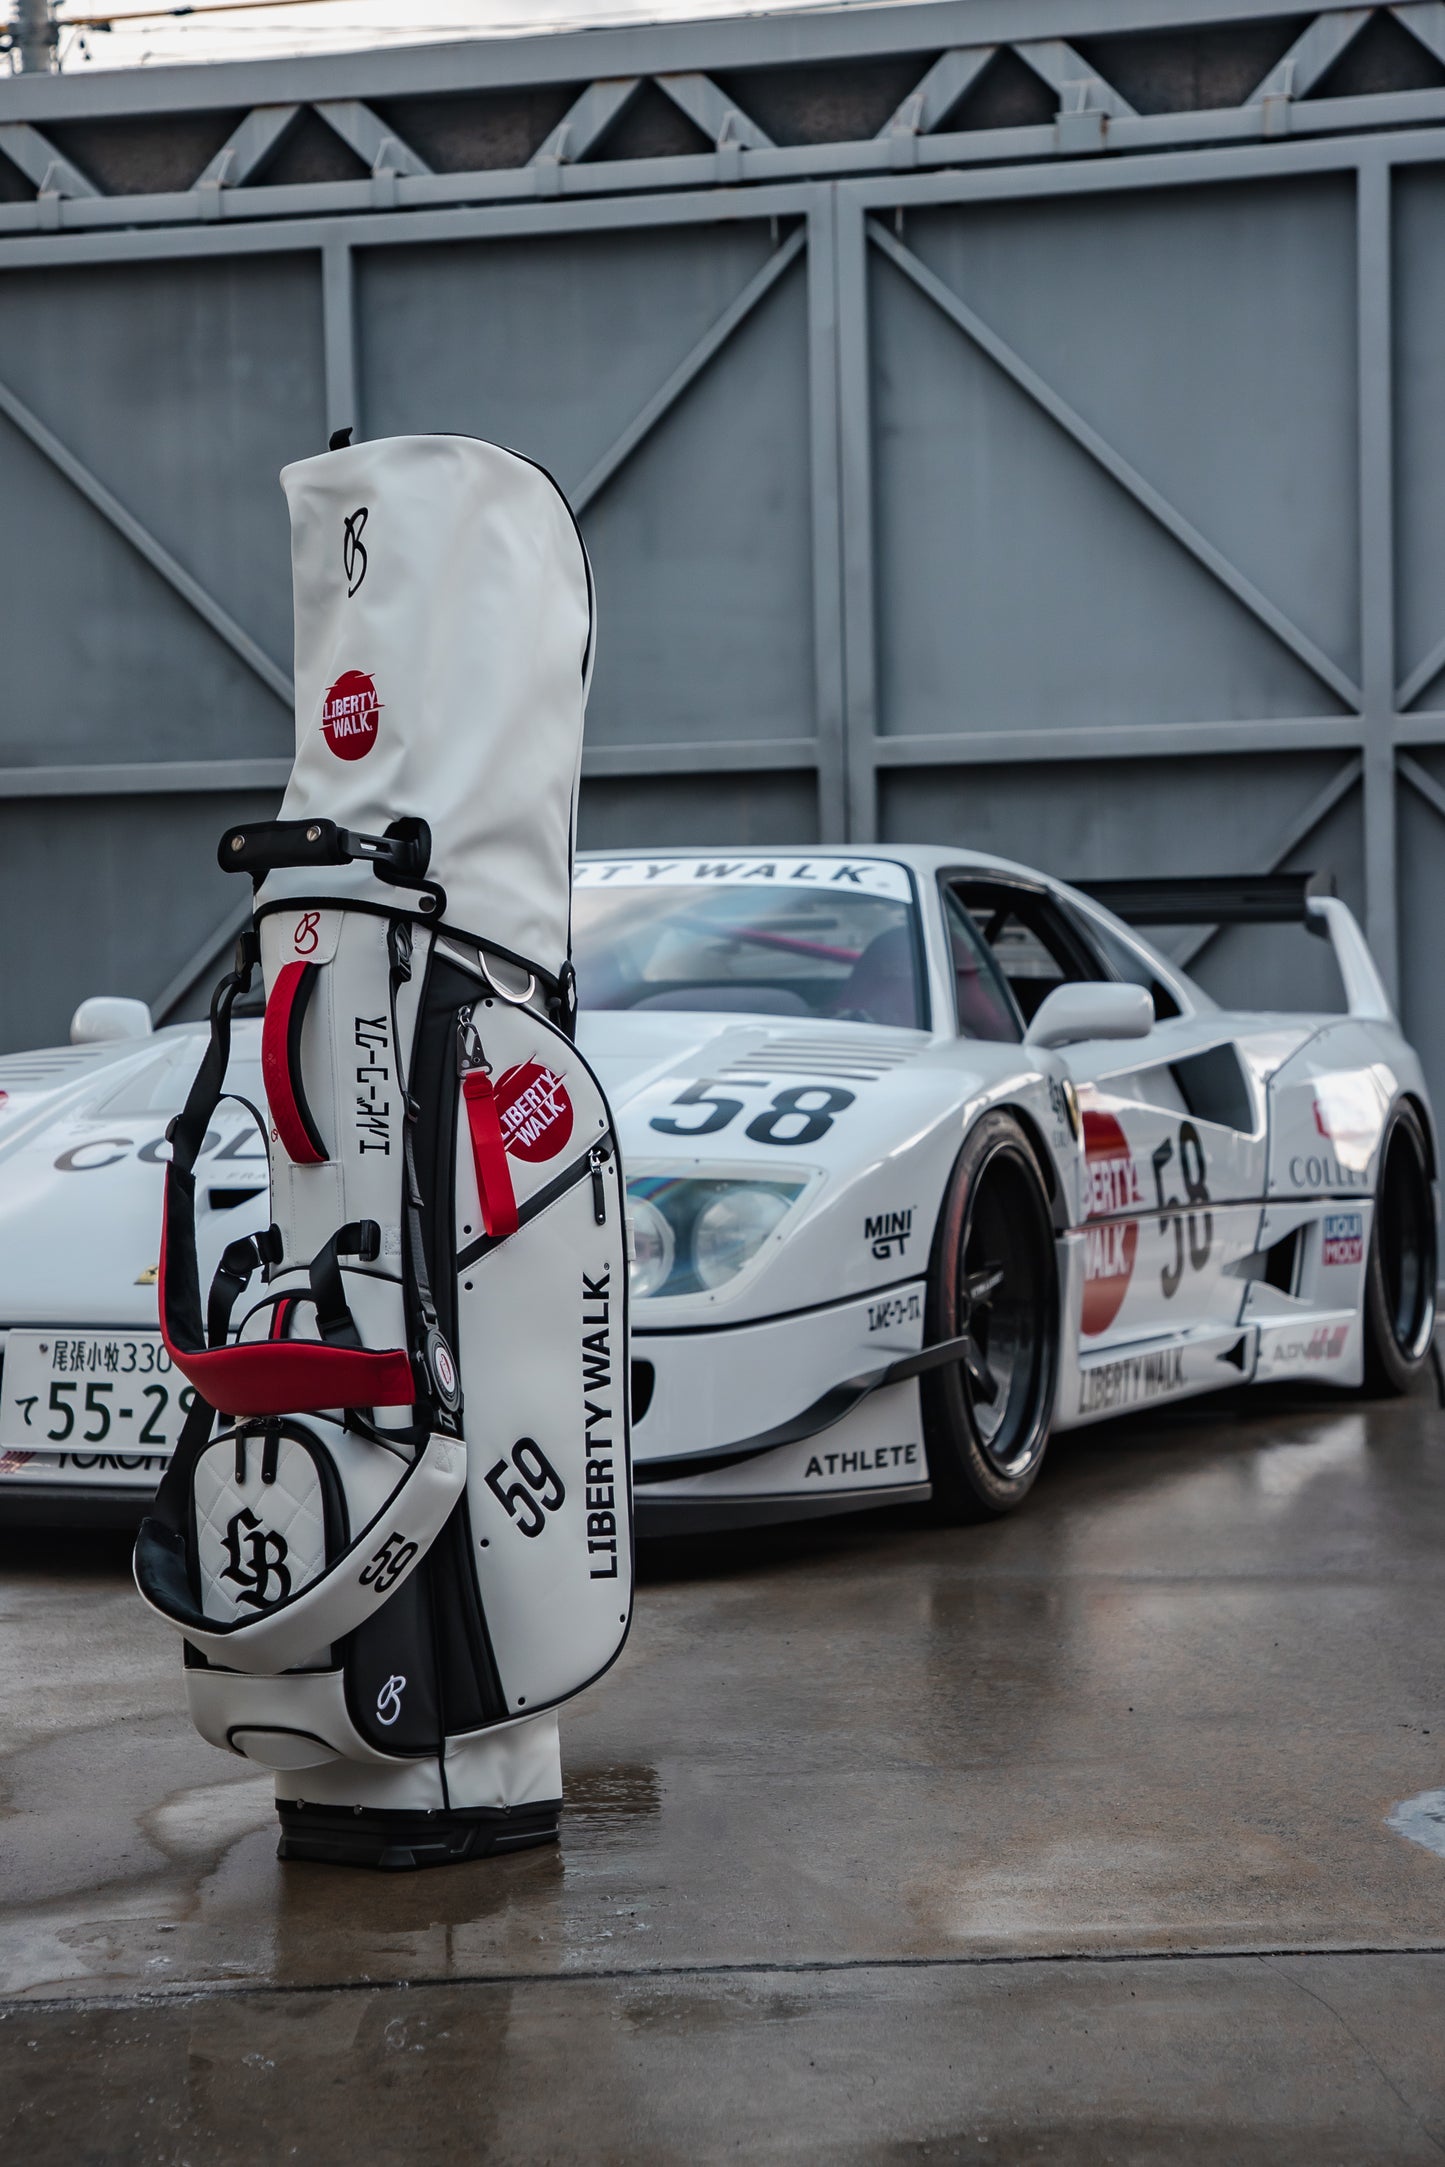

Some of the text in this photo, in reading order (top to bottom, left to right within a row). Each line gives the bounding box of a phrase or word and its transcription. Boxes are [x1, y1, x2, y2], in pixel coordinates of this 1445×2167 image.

[323, 691, 376, 720] LIBERTY
[333, 712, 371, 738] WALK
[695, 863, 873, 884] WALK
[515, 1093, 565, 1147] WALK
[649, 1079, 857, 1146] 58
[865, 1209, 912, 1239] MINI
[1152, 1121, 1212, 1299] 58
[872, 1232, 911, 1260] GT
[15, 1396, 39, 1426] て
[582, 1270, 618, 1580] LIBERTY WALK
[804, 1443, 918, 1478] ATHLETE
[483, 1437, 565, 1538] 59
[358, 1531, 419, 1593] 59
